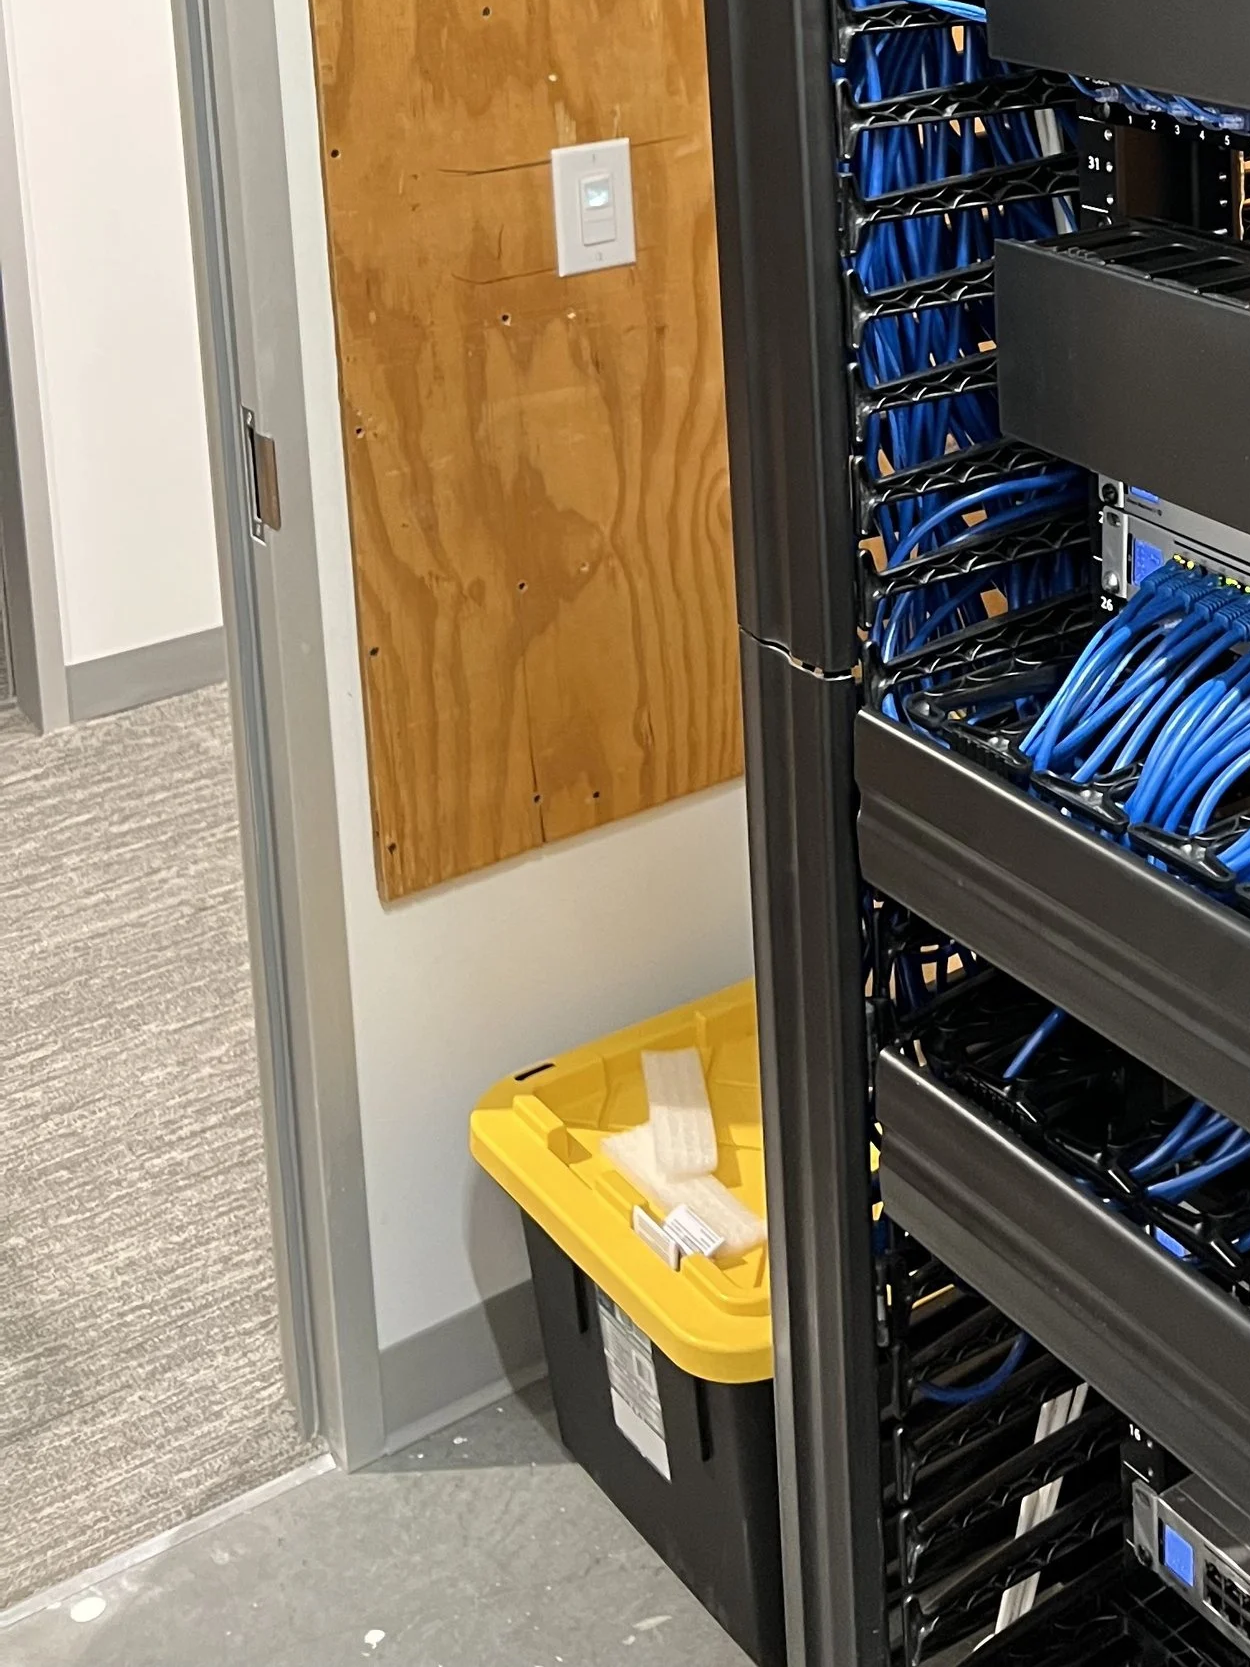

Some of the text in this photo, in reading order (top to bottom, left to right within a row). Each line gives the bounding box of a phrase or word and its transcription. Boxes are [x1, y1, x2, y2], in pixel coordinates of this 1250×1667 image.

[1128, 115, 1133, 125] 1
[1150, 119, 1157, 131] 2
[1174, 124, 1181, 136] 3
[1199, 130, 1206, 141] 4
[1224, 134, 1231, 146] 5
[1087, 155, 1100, 171] 31
[1100, 595, 1114, 612] 26
[1129, 1423, 1141, 1441] 16
